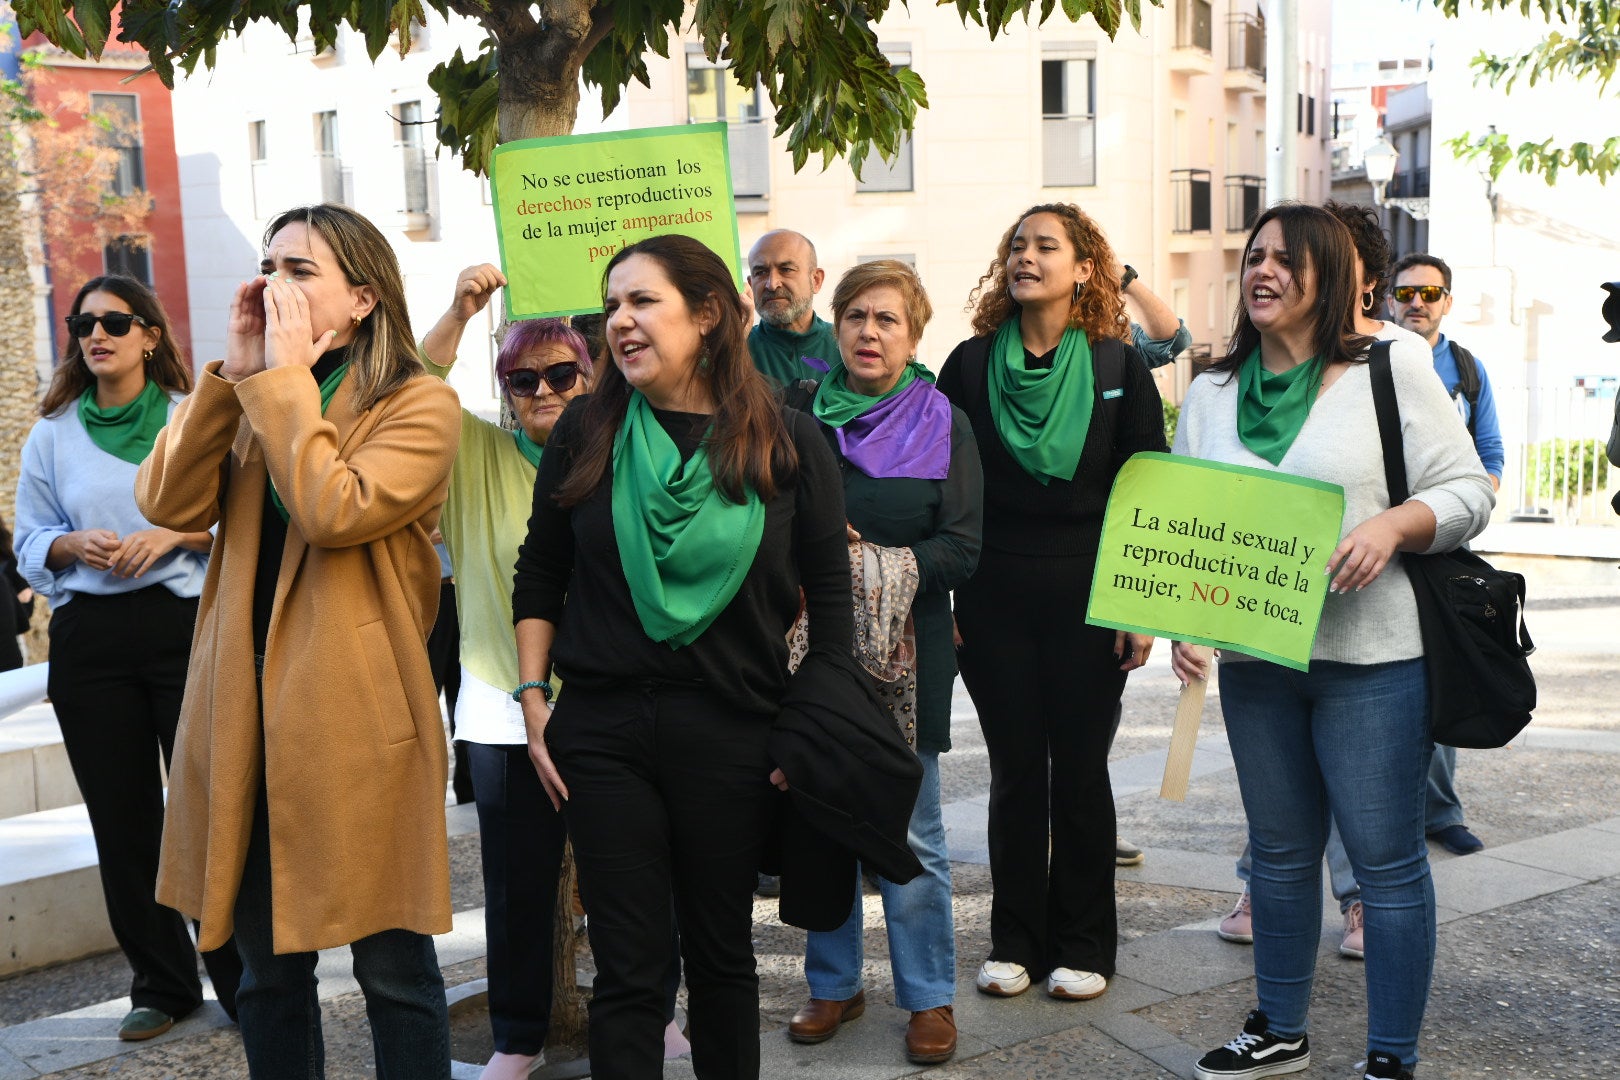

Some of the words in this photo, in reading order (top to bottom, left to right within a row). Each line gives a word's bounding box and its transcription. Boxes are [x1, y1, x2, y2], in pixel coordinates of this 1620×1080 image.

[521, 174, 547, 191] No
[554, 175, 571, 188] se
[577, 164, 667, 185] cuestionan
[677, 158, 702, 175] los
[517, 195, 592, 216] derechos
[597, 184, 712, 211] reproductivos
[523, 224, 542, 240] de
[547, 222, 563, 238] la
[568, 217, 617, 238] mujer
[623, 207, 713, 232] amparados
[589, 244, 617, 263] por
[1131, 507, 1160, 532] La
[1166, 517, 1226, 543] salud
[1231, 531, 1298, 557] sexual
[1301, 545, 1316, 566] y
[1122, 543, 1260, 581] reproductiva
[1265, 565, 1289, 588] de
[1293, 571, 1310, 594] la
[1112, 573, 1182, 603] mujer,
[1188, 582, 1230, 607] NO
[1235, 596, 1258, 613] se
[1263, 599, 1304, 626] toca.
